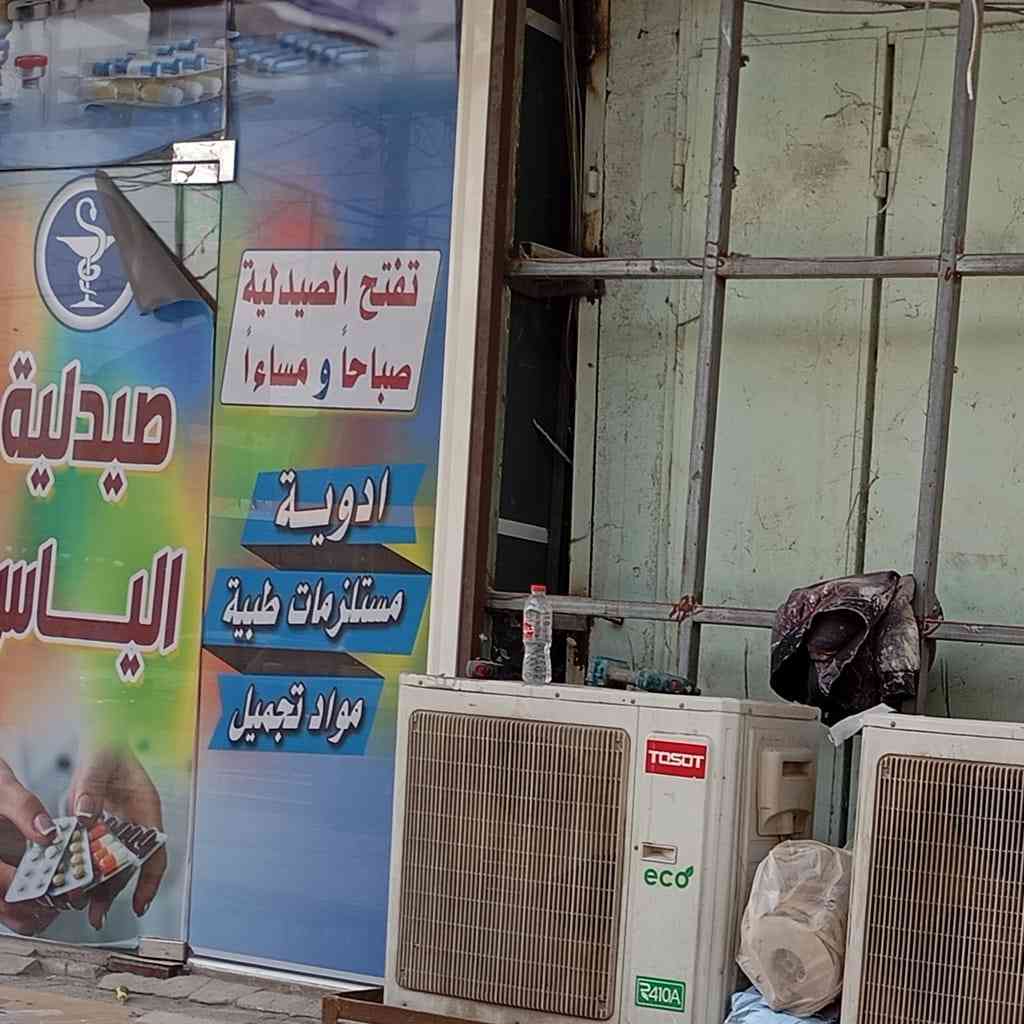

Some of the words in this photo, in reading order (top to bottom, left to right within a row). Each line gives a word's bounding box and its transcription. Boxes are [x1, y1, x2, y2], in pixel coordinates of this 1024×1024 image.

[242, 258, 349, 319] الصيدلية
[359, 257, 420, 321] تفتح
[312, 358, 331, 400] و
[1, 351, 176, 501] صيدلية
[274, 466, 390, 546] ادوية
[221, 576, 281, 640] طبية
[287, 576, 404, 639] مستلزمات
[228, 681, 304, 743] تجميل
[307, 686, 364, 744] مواد
[648, 748, 705, 769] TOSOT
[643, 865, 694, 889] eco
[638, 982, 682, 1006] R410A
